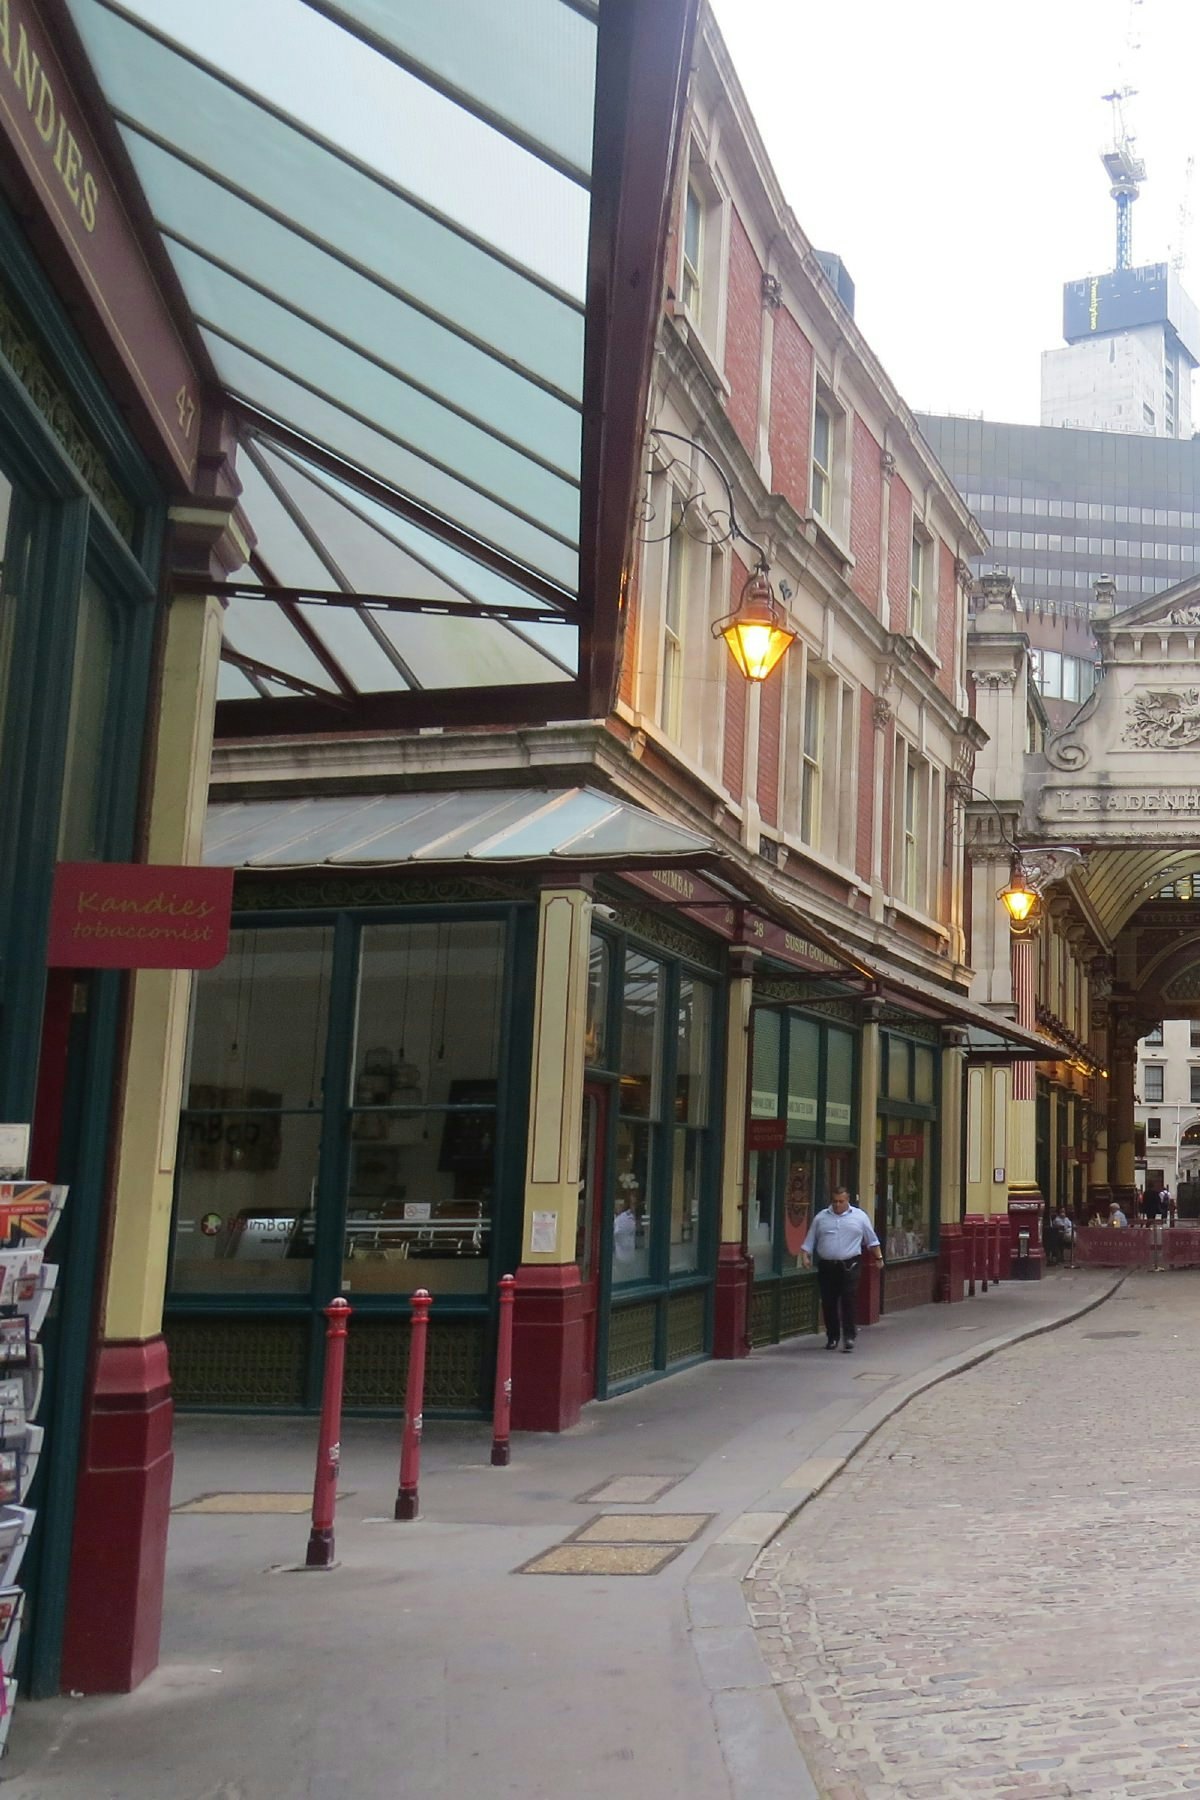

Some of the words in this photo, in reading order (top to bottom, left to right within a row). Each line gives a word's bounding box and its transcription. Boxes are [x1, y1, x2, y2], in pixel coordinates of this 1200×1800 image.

[175, 384, 195, 438] 47
[78, 891, 215, 919] Kandies
[72, 919, 213, 942] tobacconist
[784, 932, 808, 956] SUSHI
